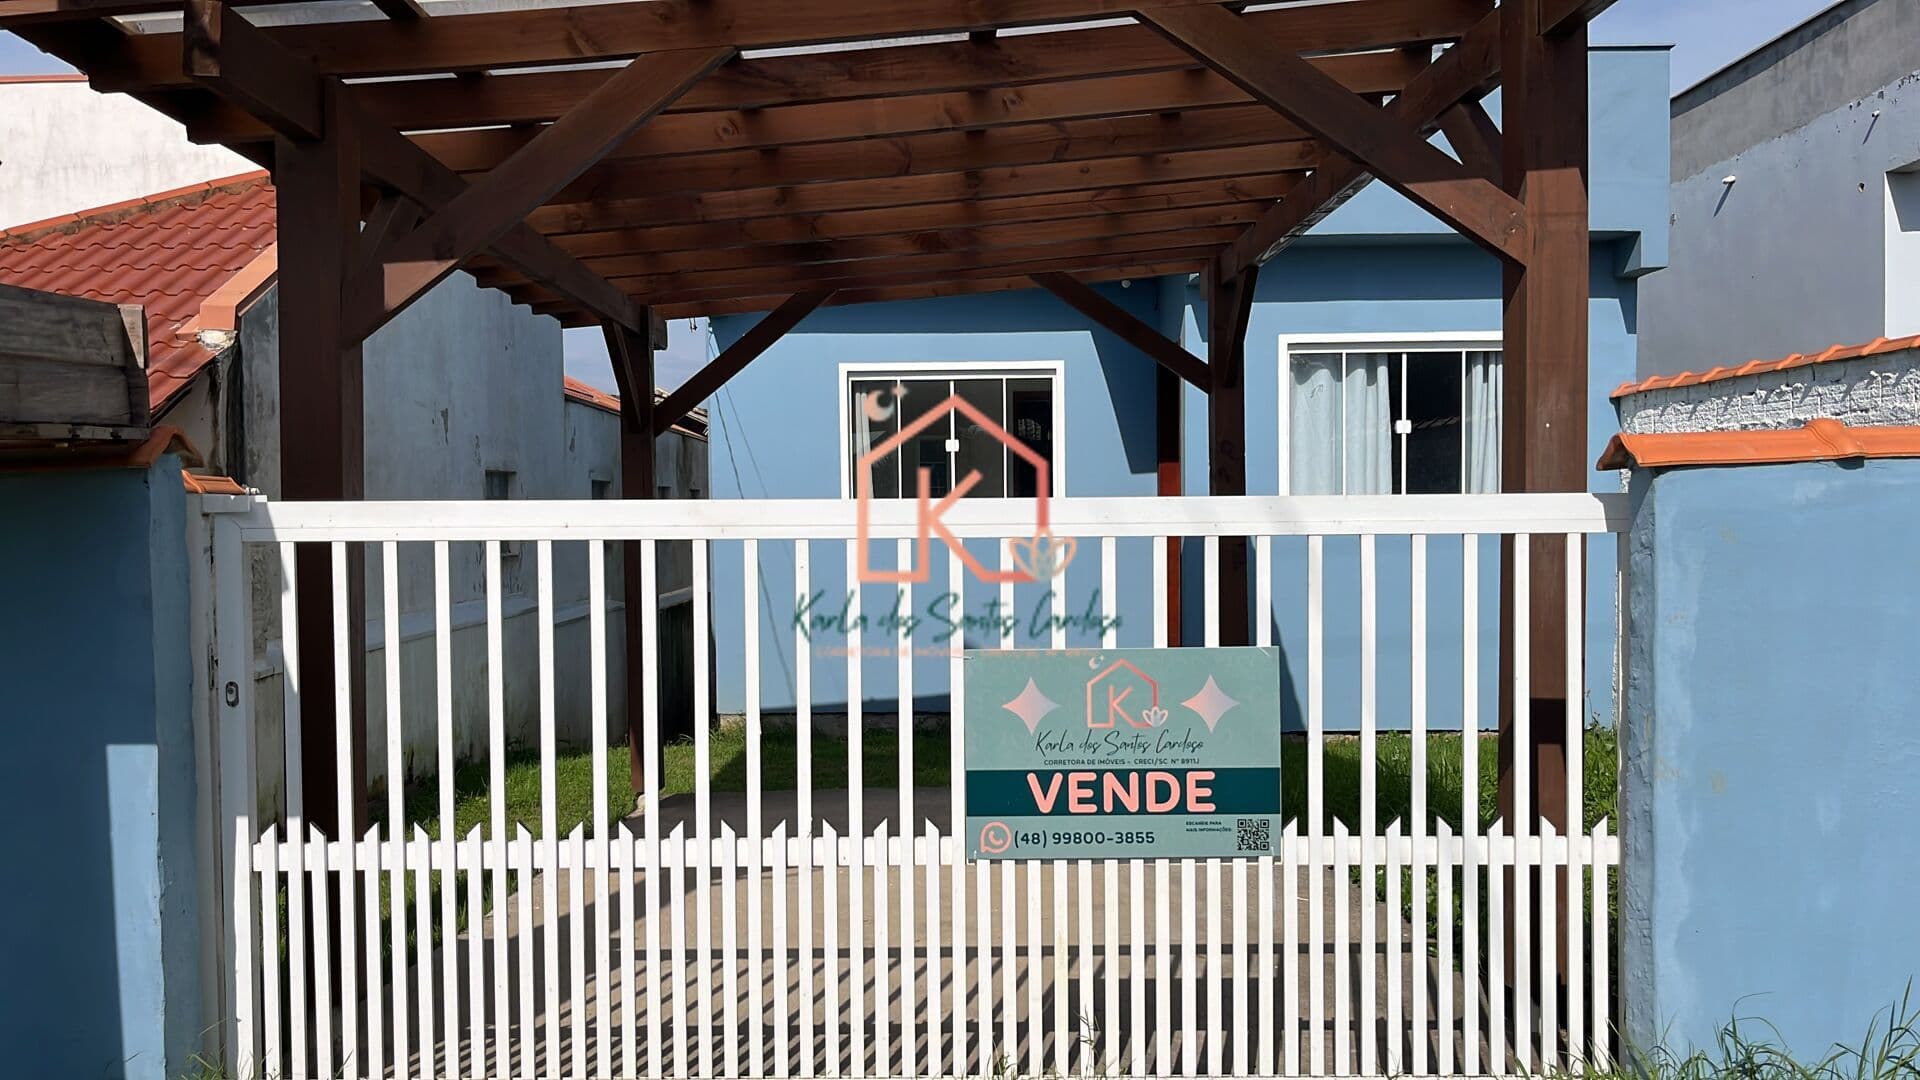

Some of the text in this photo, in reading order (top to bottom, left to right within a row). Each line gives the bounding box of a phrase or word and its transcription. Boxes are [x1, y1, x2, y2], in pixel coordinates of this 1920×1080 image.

[1035, 728, 1204, 757] Karla dos Santos Cardoso
[1097, 757, 1126, 766] IMÓVEIS
[1133, 757, 1168, 766] CRECI/SC
[1026, 770, 1216, 814] VENDE
[1014, 830, 1156, 849] (48) 99800-3855
